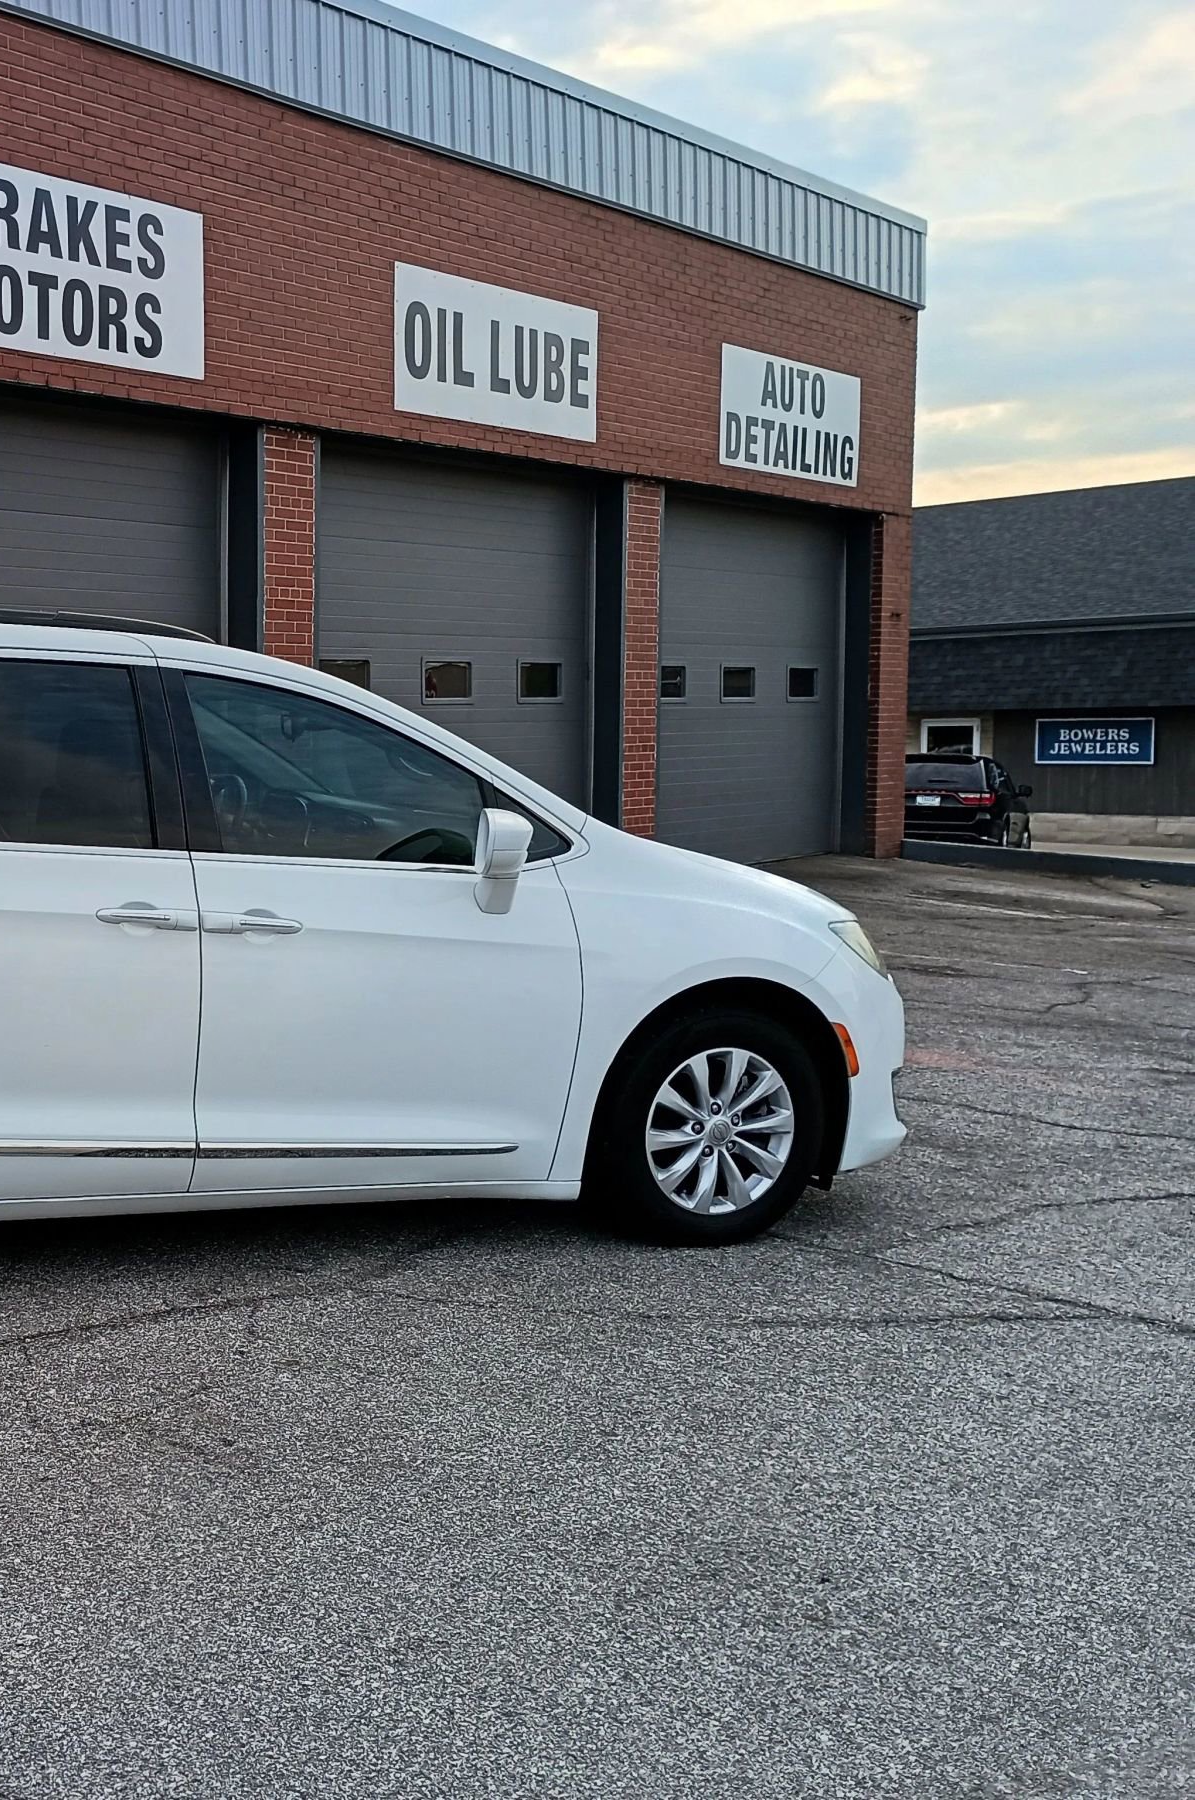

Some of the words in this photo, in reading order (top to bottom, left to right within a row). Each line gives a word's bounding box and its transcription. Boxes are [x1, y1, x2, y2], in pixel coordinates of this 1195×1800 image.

[404, 300, 475, 388] OIL
[490, 319, 590, 409] LUBE
[761, 360, 826, 419] AUTO
[725, 411, 854, 481] DETAILING
[1049, 742, 1140, 755] JEWELERS
[1059, 728, 1130, 741] BOWERS
